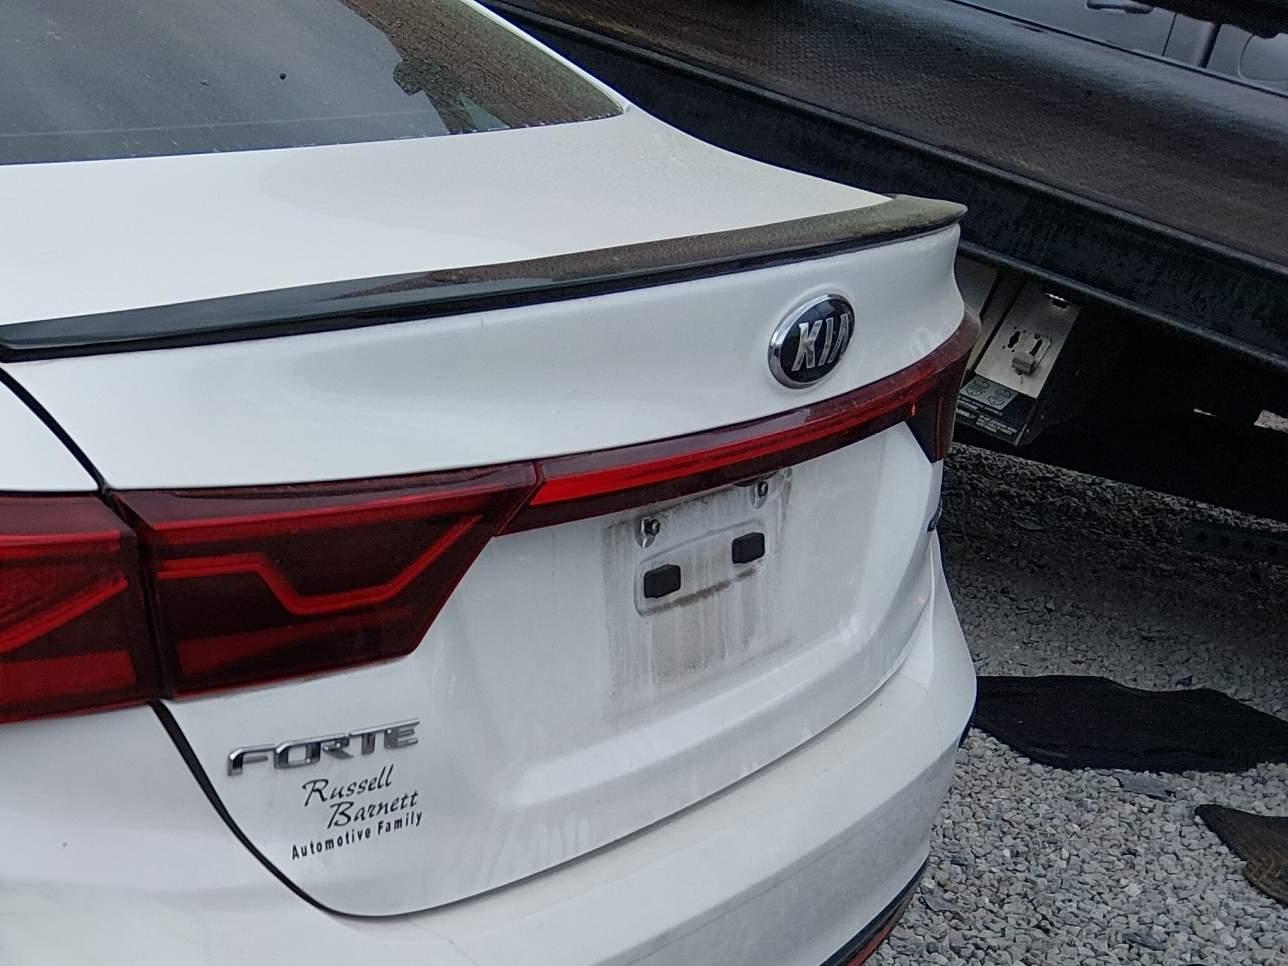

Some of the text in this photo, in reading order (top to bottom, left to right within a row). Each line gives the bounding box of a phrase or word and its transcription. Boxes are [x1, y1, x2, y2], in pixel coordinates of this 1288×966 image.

[791, 313, 850, 371] KIA
[227, 718, 420, 776] FORTE
[302, 764, 394, 807] Russell
[327, 790, 419, 829] Barnett
[292, 810, 422, 860] Automotive Family
